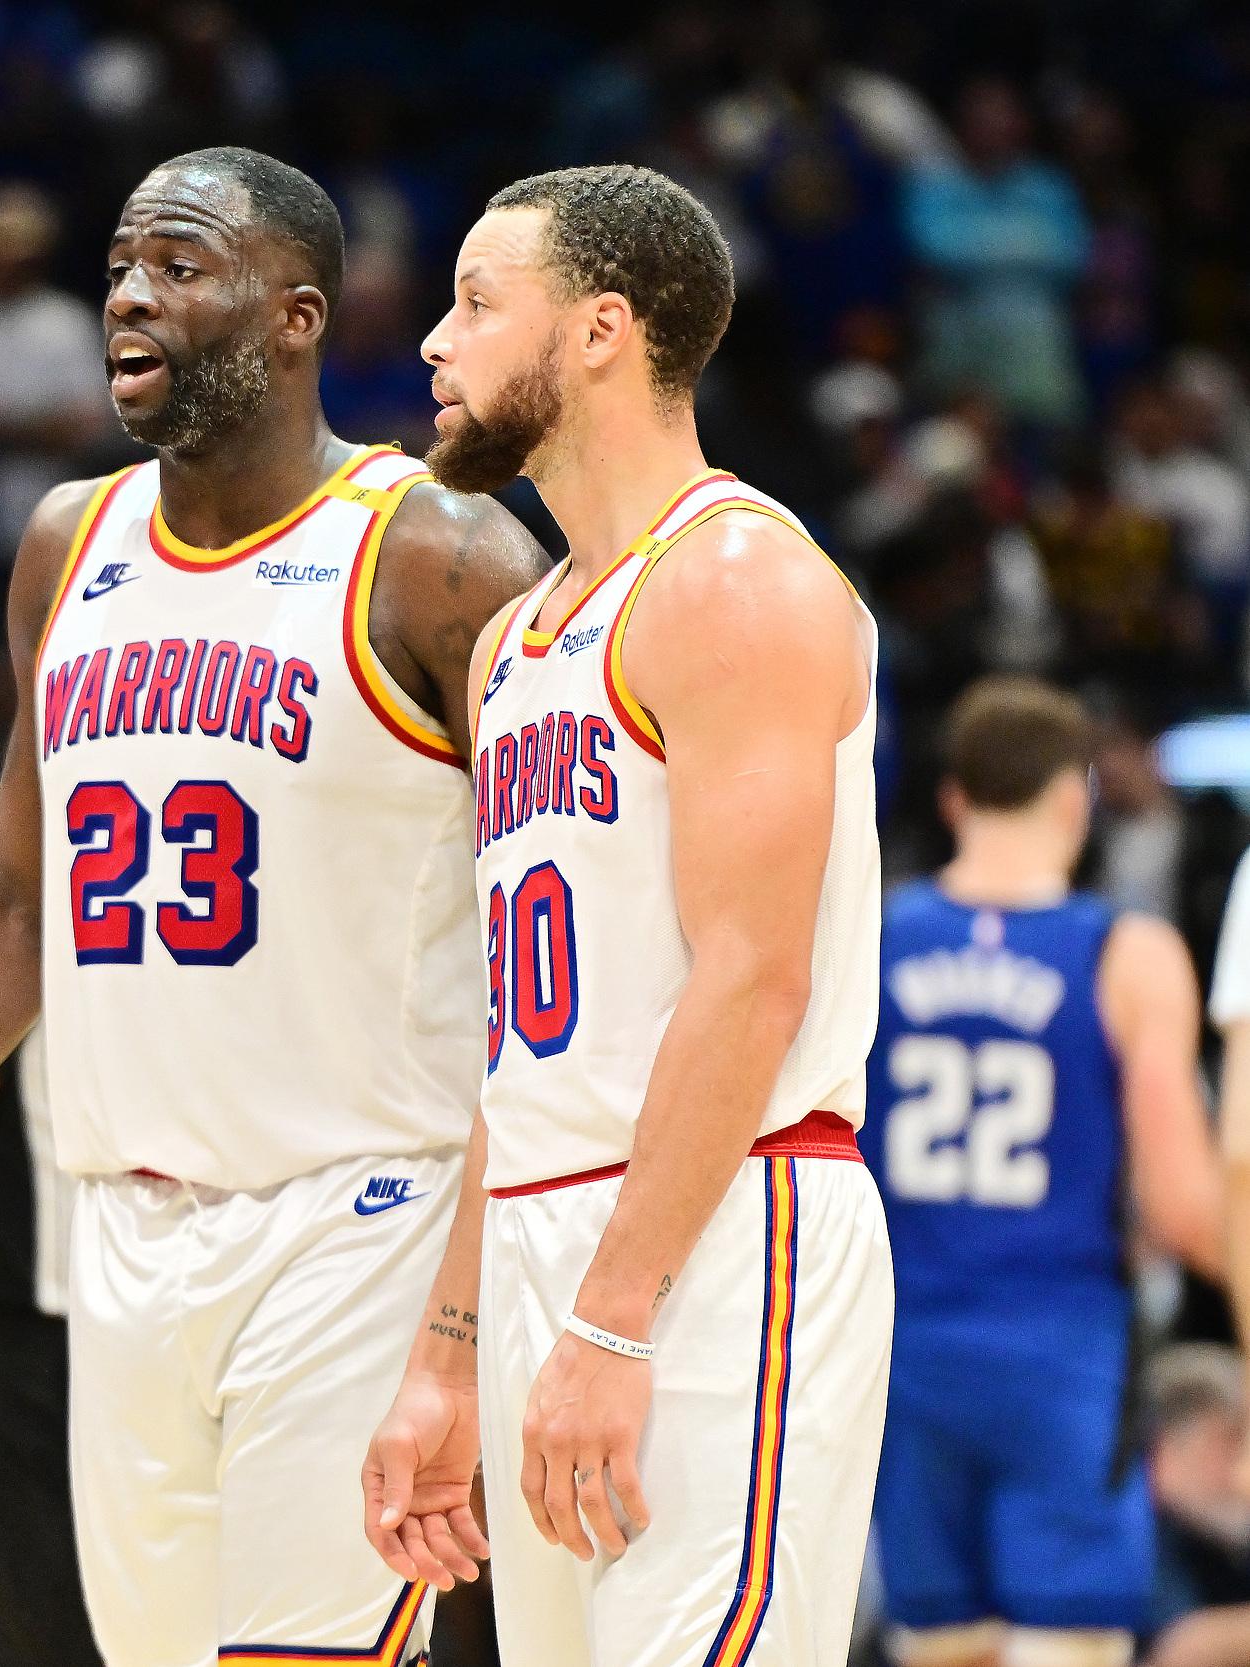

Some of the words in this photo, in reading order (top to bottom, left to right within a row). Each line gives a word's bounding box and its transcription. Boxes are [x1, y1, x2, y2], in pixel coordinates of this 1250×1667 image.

[95, 563, 132, 585] NIKE
[255, 560, 340, 582] Rakuten
[43, 638, 319, 763] WARRIORS
[475, 711, 619, 860] ARRORS
[66, 779, 260, 967] 23
[885, 1032, 1055, 1209] 22
[364, 1176, 414, 1200] NIKE
[590, 1331, 617, 1347] PLAY
